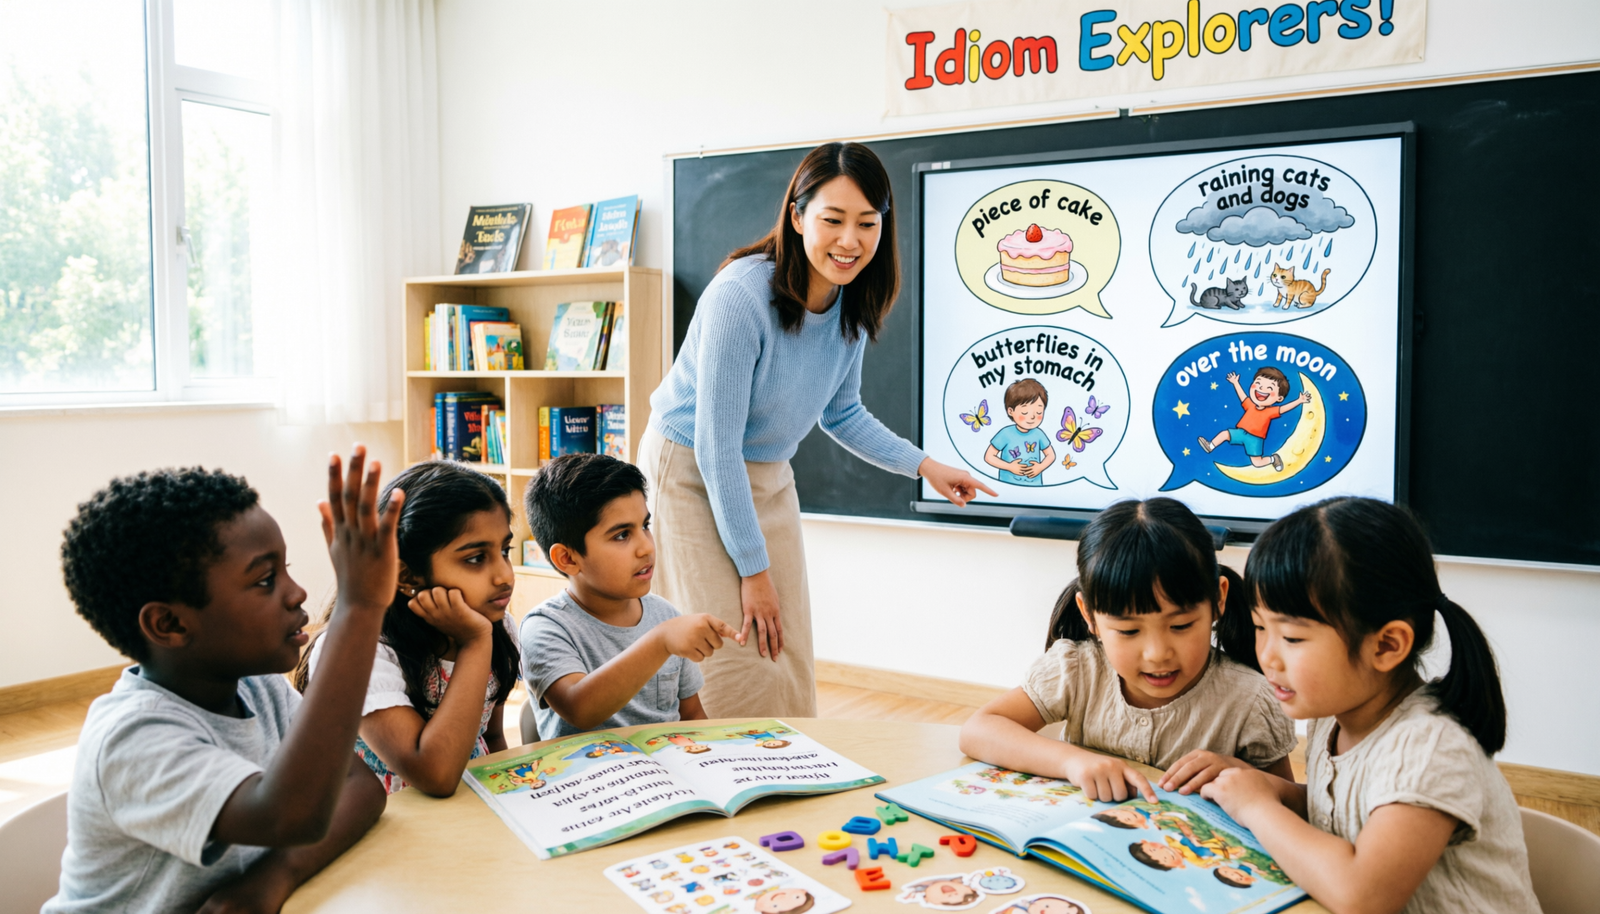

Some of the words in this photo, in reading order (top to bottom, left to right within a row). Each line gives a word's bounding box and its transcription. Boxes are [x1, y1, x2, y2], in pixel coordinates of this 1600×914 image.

[904, 28, 1058, 90] Idiom
[1078, 0, 1395, 81] Explorers!
[1198, 166, 1275, 197] raining
[1283, 168, 1331, 192] cats
[1216, 187, 1253, 210] and
[1261, 187, 1310, 210] dogs
[972, 199, 1022, 238] piece
[1028, 189, 1051, 209] of
[1056, 194, 1103, 226] cake
[971, 333, 1080, 369] butterflies
[1085, 348, 1103, 371] in
[1175, 352, 1221, 388] over
[1228, 340, 1268, 365] the
[1275, 345, 1338, 382] moon
[978, 364, 1006, 389] my
[1013, 357, 1097, 391] stomach
[867, 837, 898, 860] H
[854, 866, 891, 892] E
